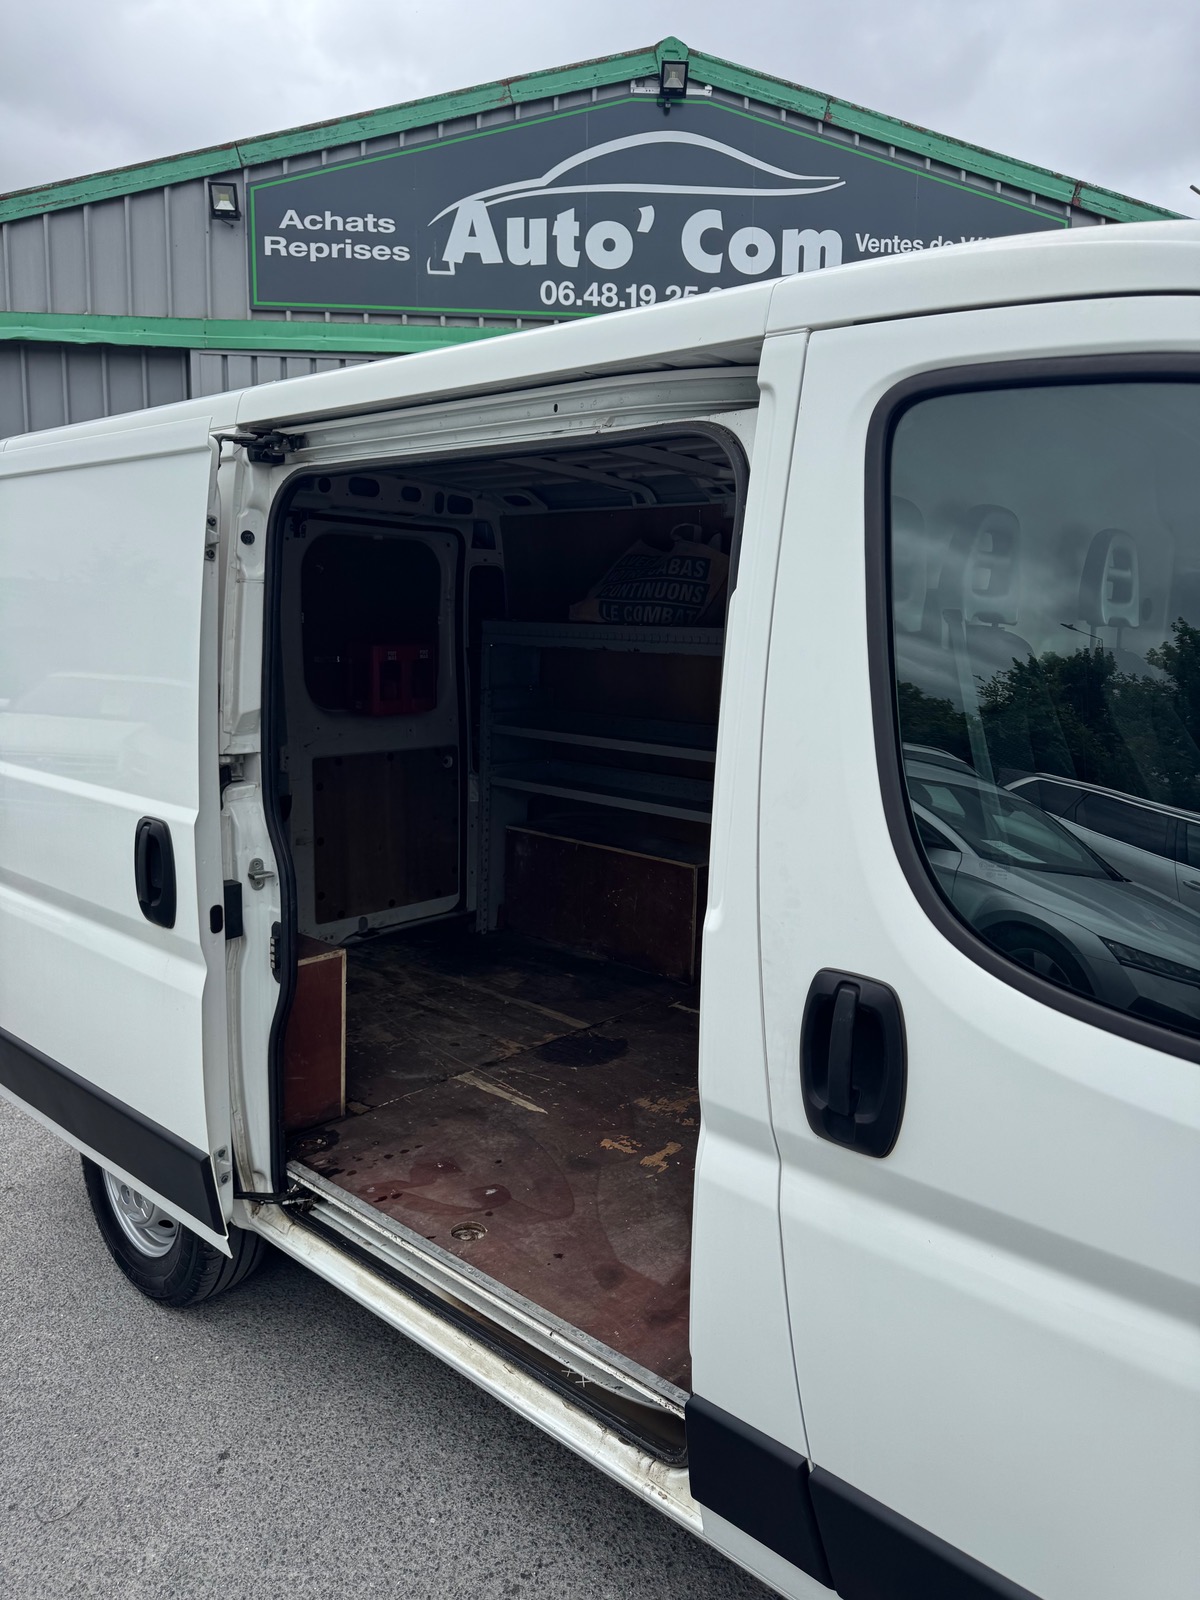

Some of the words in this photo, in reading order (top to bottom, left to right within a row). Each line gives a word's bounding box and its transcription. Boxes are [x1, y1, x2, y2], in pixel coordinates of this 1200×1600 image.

[278, 209, 396, 234] Achats
[264, 236, 411, 262] Reprises
[441, 200, 655, 270] Auto'
[681, 208, 843, 275] Com
[855, 233, 924, 253] Ventes
[601, 582, 704, 603] CONTINUONS
[602, 604, 619, 622] LE
[623, 605, 696, 624] COMBAT
